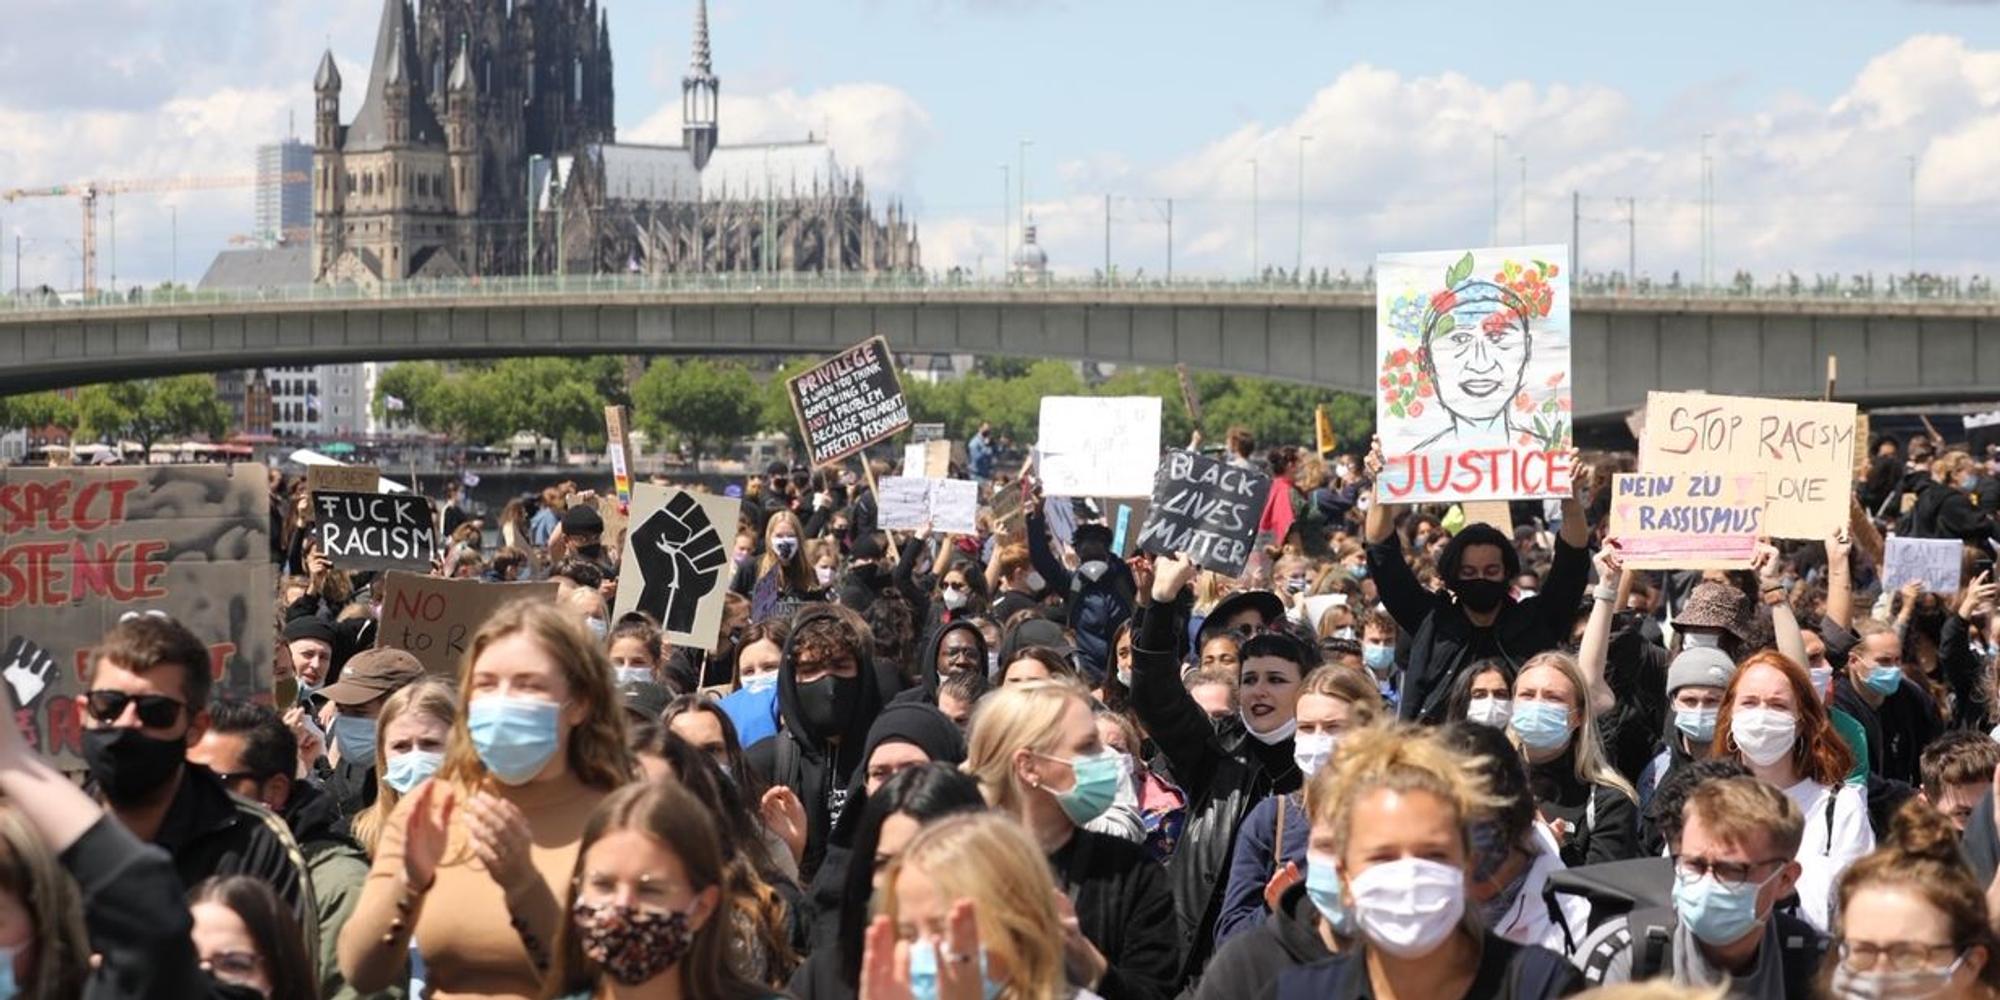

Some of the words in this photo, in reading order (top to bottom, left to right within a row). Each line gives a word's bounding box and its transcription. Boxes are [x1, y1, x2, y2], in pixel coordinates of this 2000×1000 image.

[798, 344, 877, 396] PRIVILEGE
[811, 384, 834, 402] WHEN
[836, 377, 852, 391] YOU
[851, 362, 882, 380] THINK
[859, 380, 870, 393] IS
[807, 414, 828, 432] NOT
[828, 411, 837, 423] A
[835, 387, 885, 417] PROBLEM
[811, 414, 860, 445] BECAUSE
[858, 406, 877, 423] YOU
[815, 431, 862, 462] AFFECTED
[1660, 407, 1742, 454] STOP
[1758, 416, 1855, 467] RACISM
[1170, 452, 1258, 497] BLACK
[1386, 447, 1571, 496] JUSTICE
[1619, 475, 1673, 497] NEIN
[1687, 474, 1721, 497] ZU
[0, 479, 139, 534] SPECT
[318, 496, 416, 524] FUCK
[1162, 488, 1249, 531] LIVES
[1639, 505, 1763, 533] RASSISMUS
[323, 522, 435, 562] RACISM
[1136, 518, 1246, 566] MATTER
[0, 539, 169, 608] STENCE
[392, 589, 447, 622] NO
[403, 625, 433, 651] to
